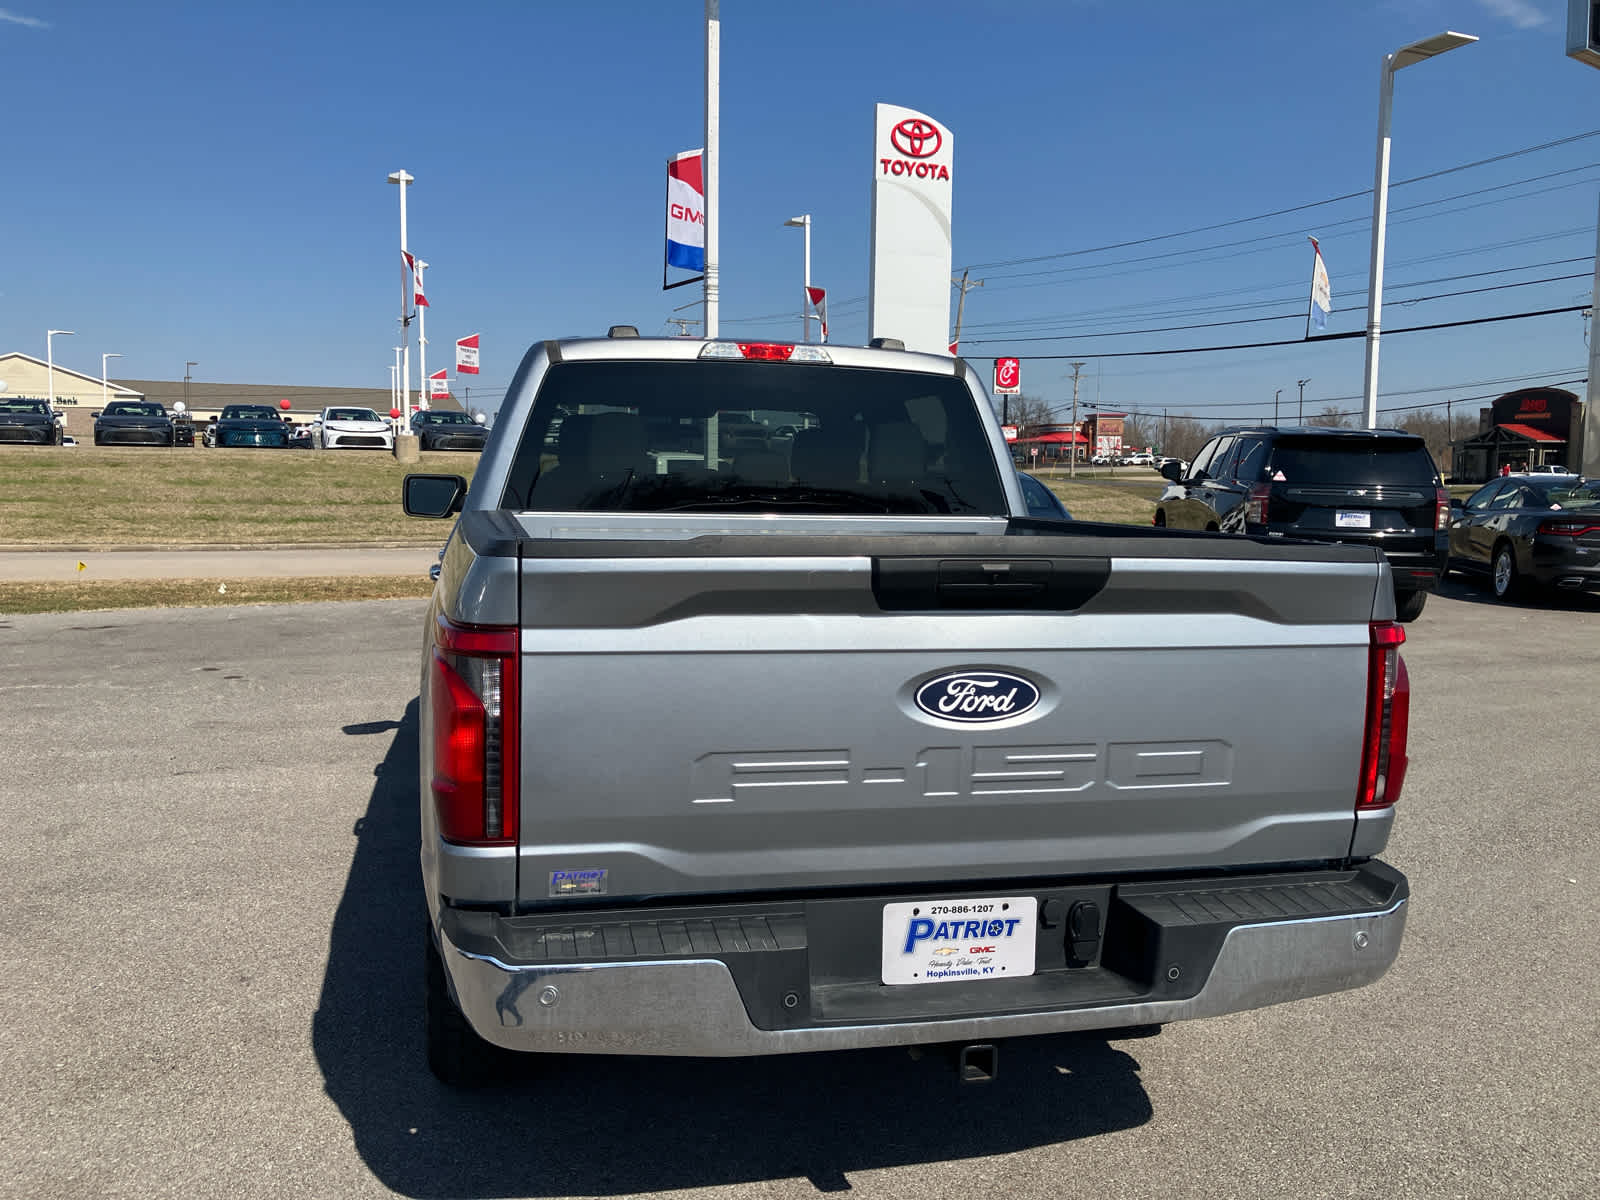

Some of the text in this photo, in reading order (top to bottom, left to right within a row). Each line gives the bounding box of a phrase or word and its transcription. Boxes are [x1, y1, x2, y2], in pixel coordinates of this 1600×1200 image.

[880, 158, 949, 181] TOYOTA
[938, 679, 1018, 712] Ford
[692, 738, 1233, 803] F-150
[931, 904, 995, 915] 270-886-1207
[904, 918, 1020, 953] PATRIOT
[969, 946, 996, 954] GMC
[926, 966, 996, 978] Hopkinsville, KY
